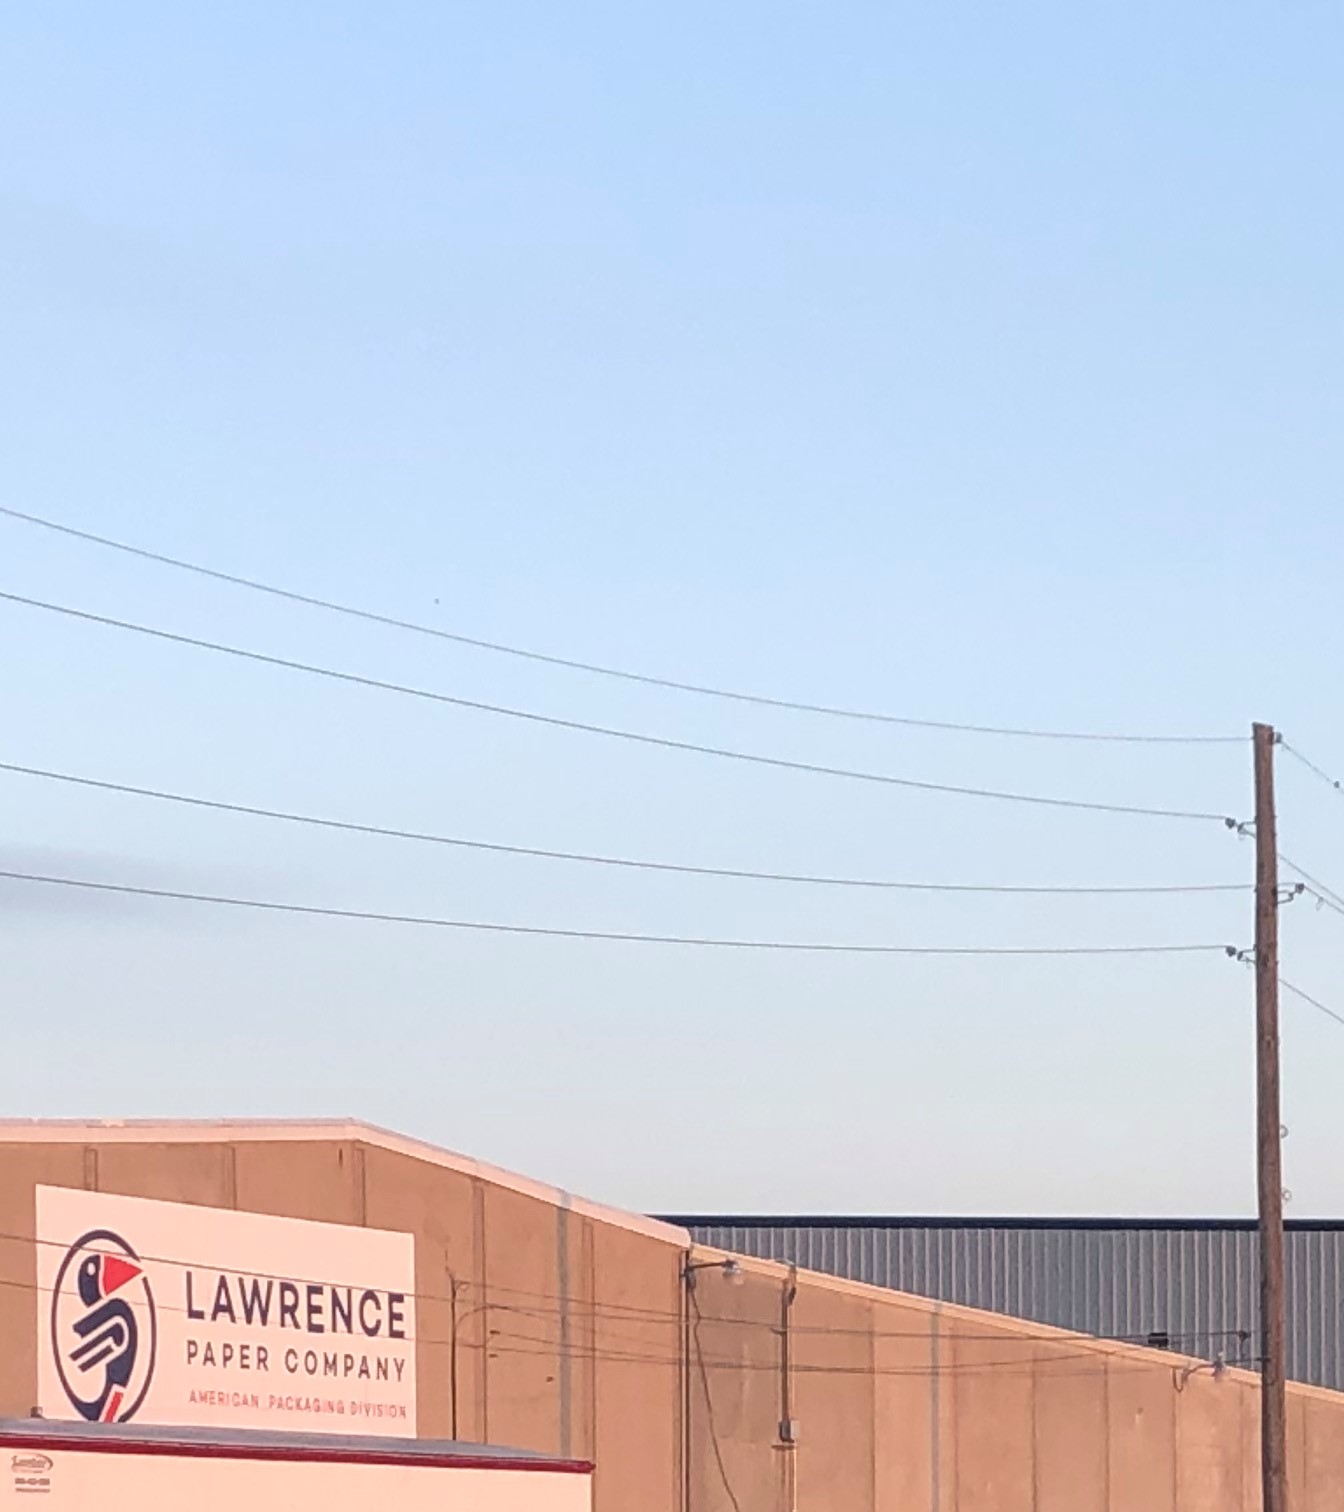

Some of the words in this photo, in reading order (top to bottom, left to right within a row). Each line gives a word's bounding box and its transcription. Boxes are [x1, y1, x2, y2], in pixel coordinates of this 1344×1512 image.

[186, 1271, 405, 1338] LAWRENCE
[186, 1340, 269, 1371] PAPER
[284, 1348, 405, 1382] COMPANY
[189, 1389, 259, 1409] AMERICAN
[268, 1394, 345, 1415] PACKAGING
[350, 1400, 407, 1419] DIVISION
